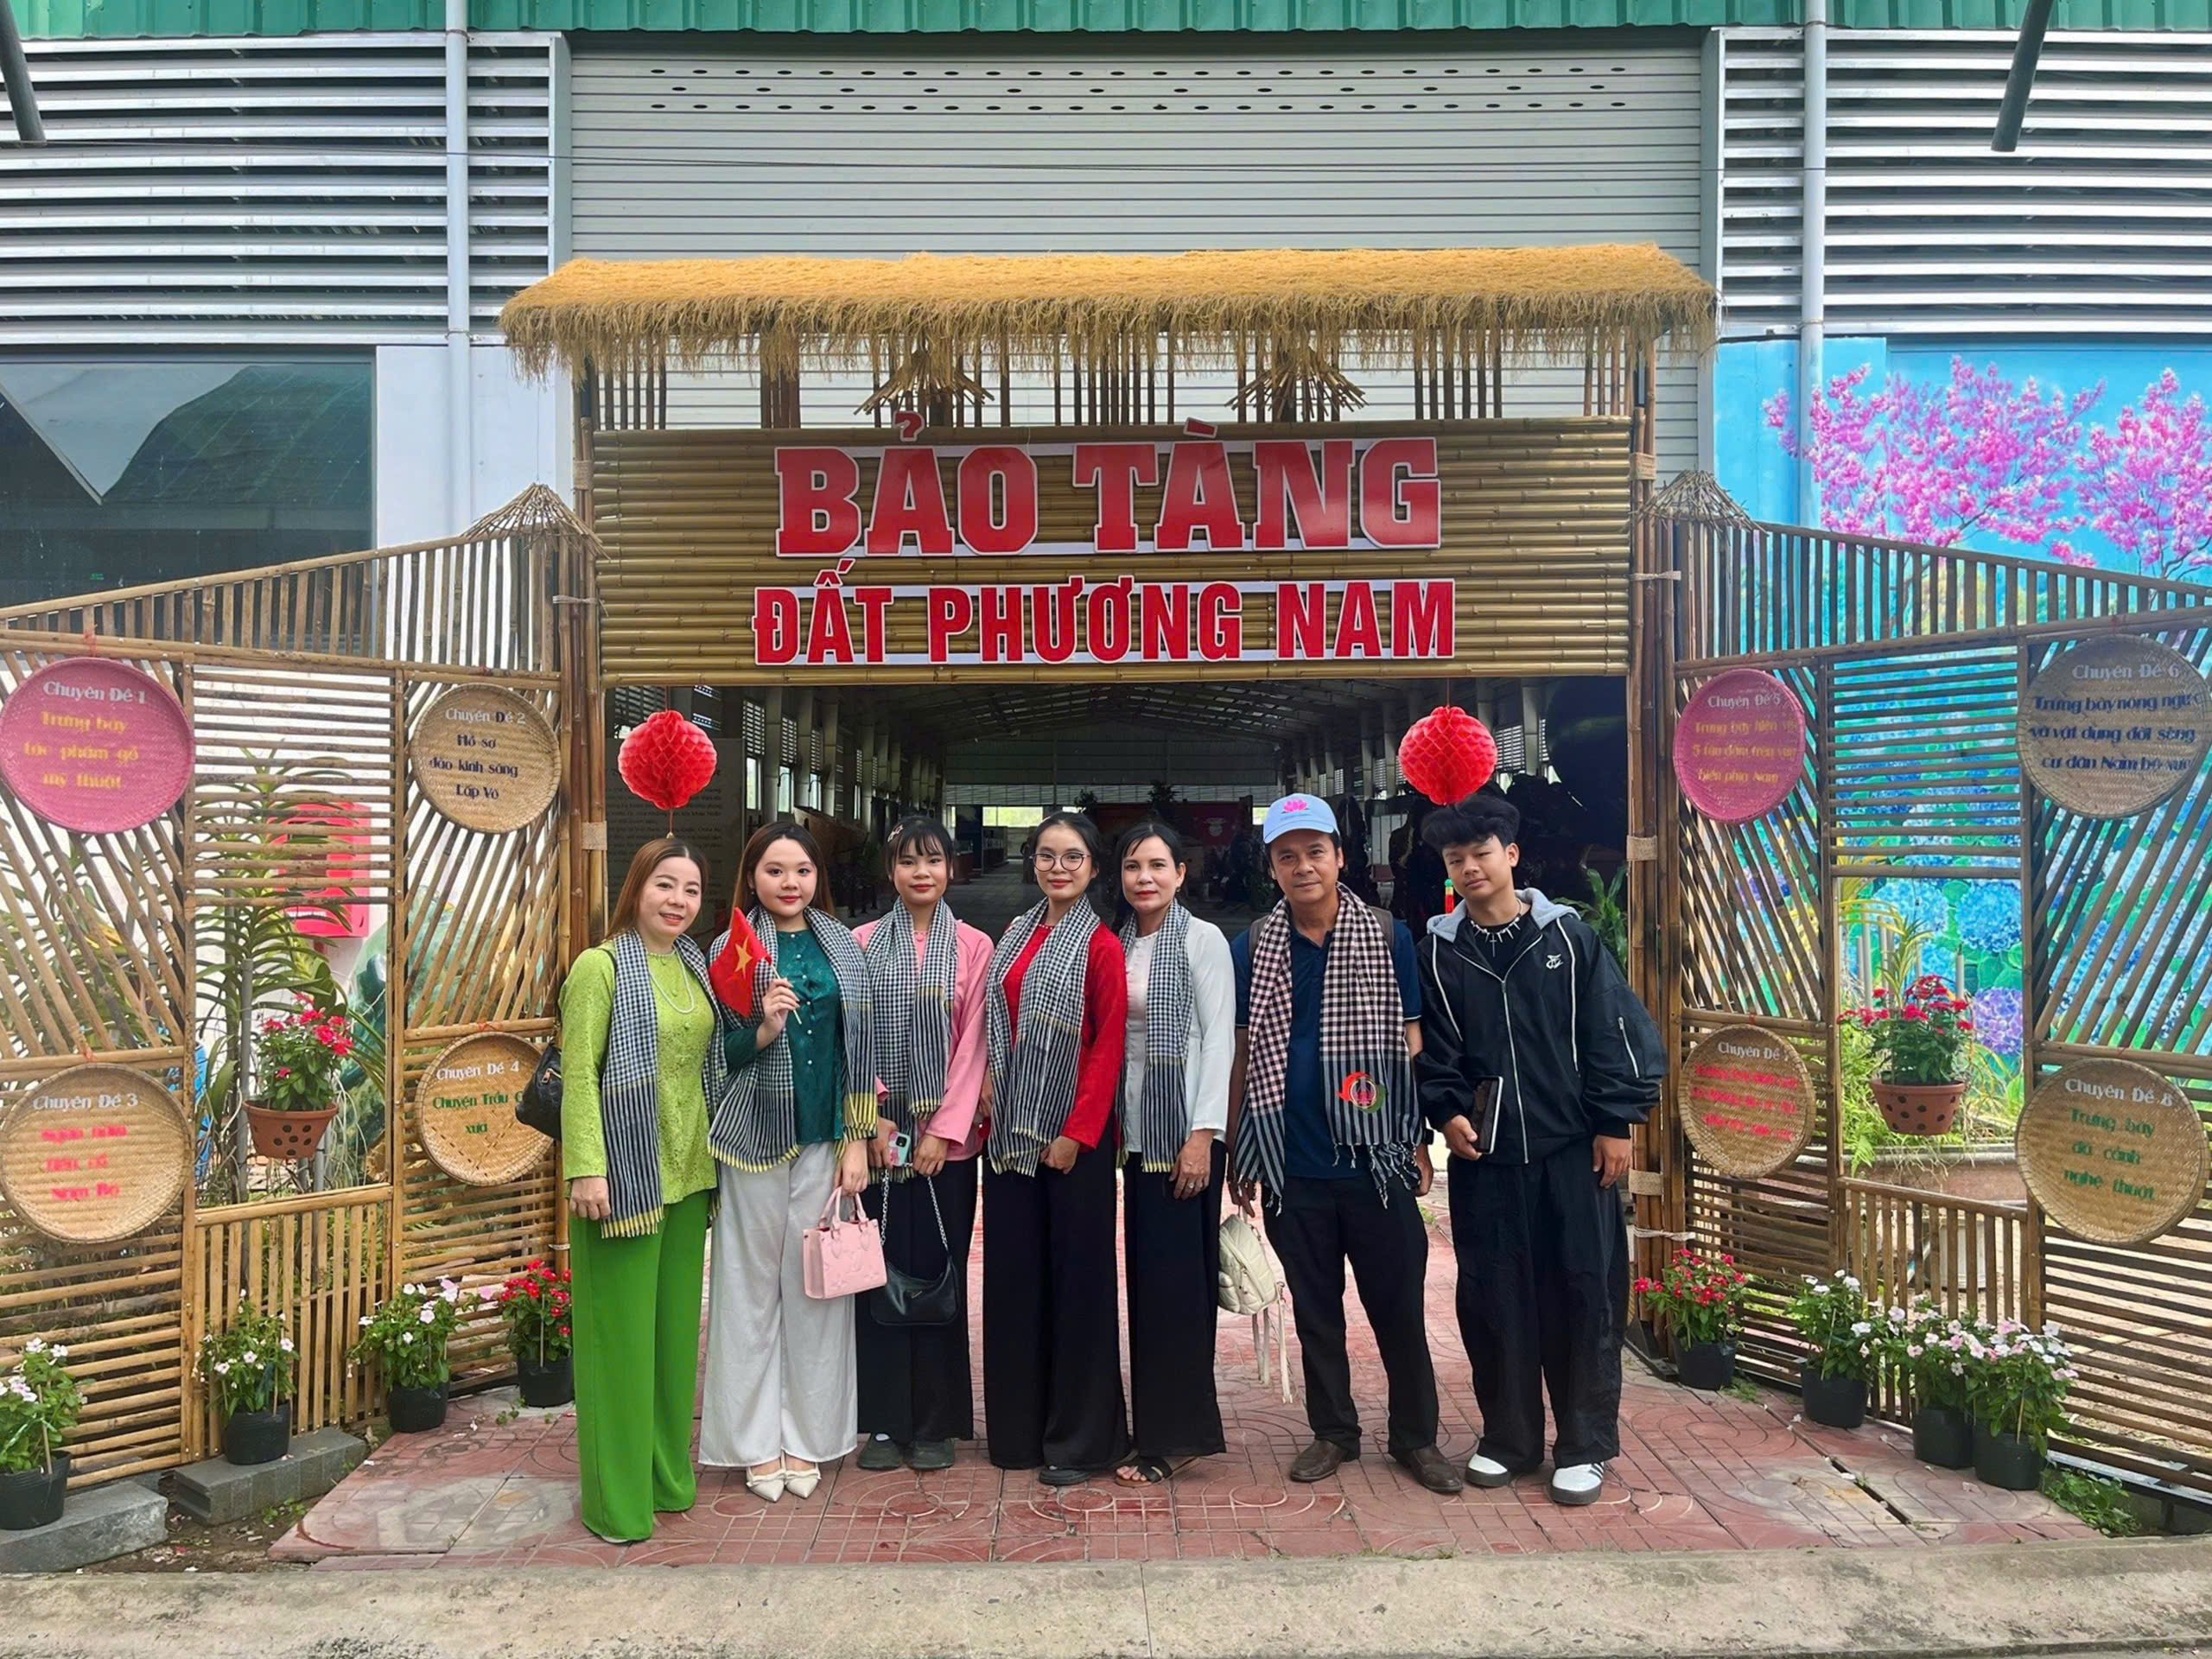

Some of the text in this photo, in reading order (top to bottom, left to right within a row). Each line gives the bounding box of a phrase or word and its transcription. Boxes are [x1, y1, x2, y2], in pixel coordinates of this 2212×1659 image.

[774, 411, 1441, 557] BẢO TÀNG
[751, 558, 1454, 665] ĐẤT PHƯƠNG NAM
[518, 713, 526, 725] 2
[511, 1060, 519, 1072] 4
[127, 1093, 139, 1107] 3
